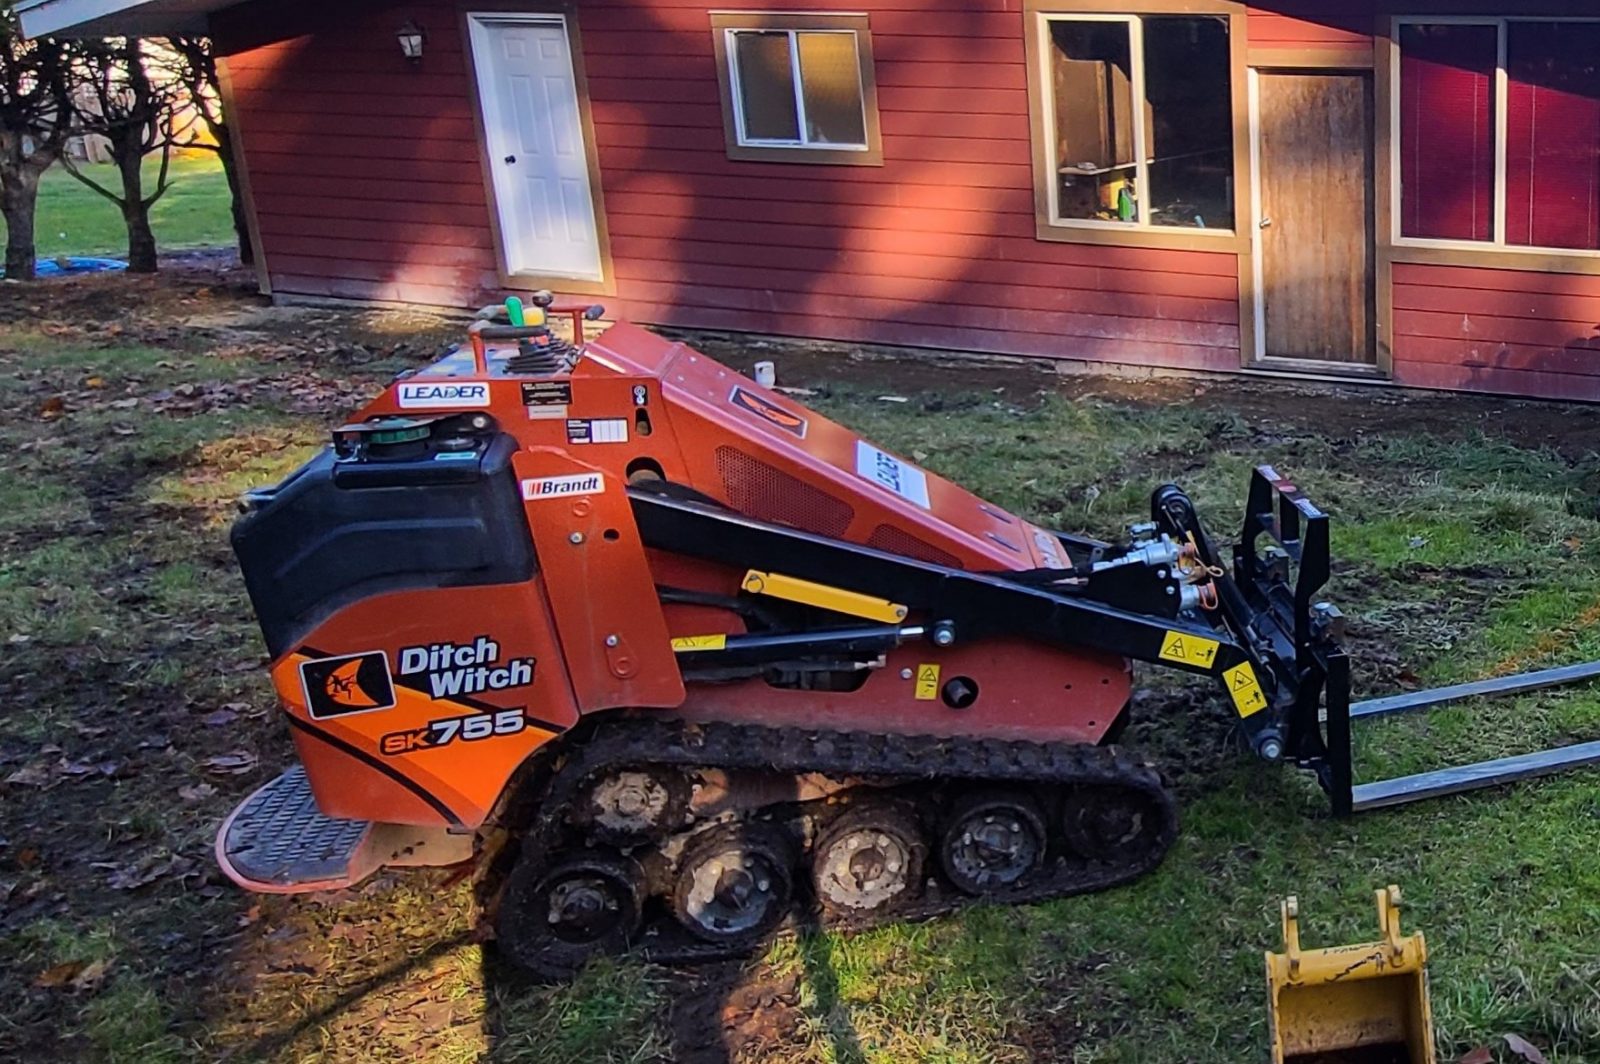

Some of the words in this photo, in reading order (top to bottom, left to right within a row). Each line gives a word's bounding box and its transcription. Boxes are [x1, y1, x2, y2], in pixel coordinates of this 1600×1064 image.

[403, 385, 486, 400] LEADER
[541, 477, 598, 495] Brandt
[400, 637, 499, 676] Ditch
[429, 659, 534, 699] Witch
[383, 708, 525, 753] SK755
